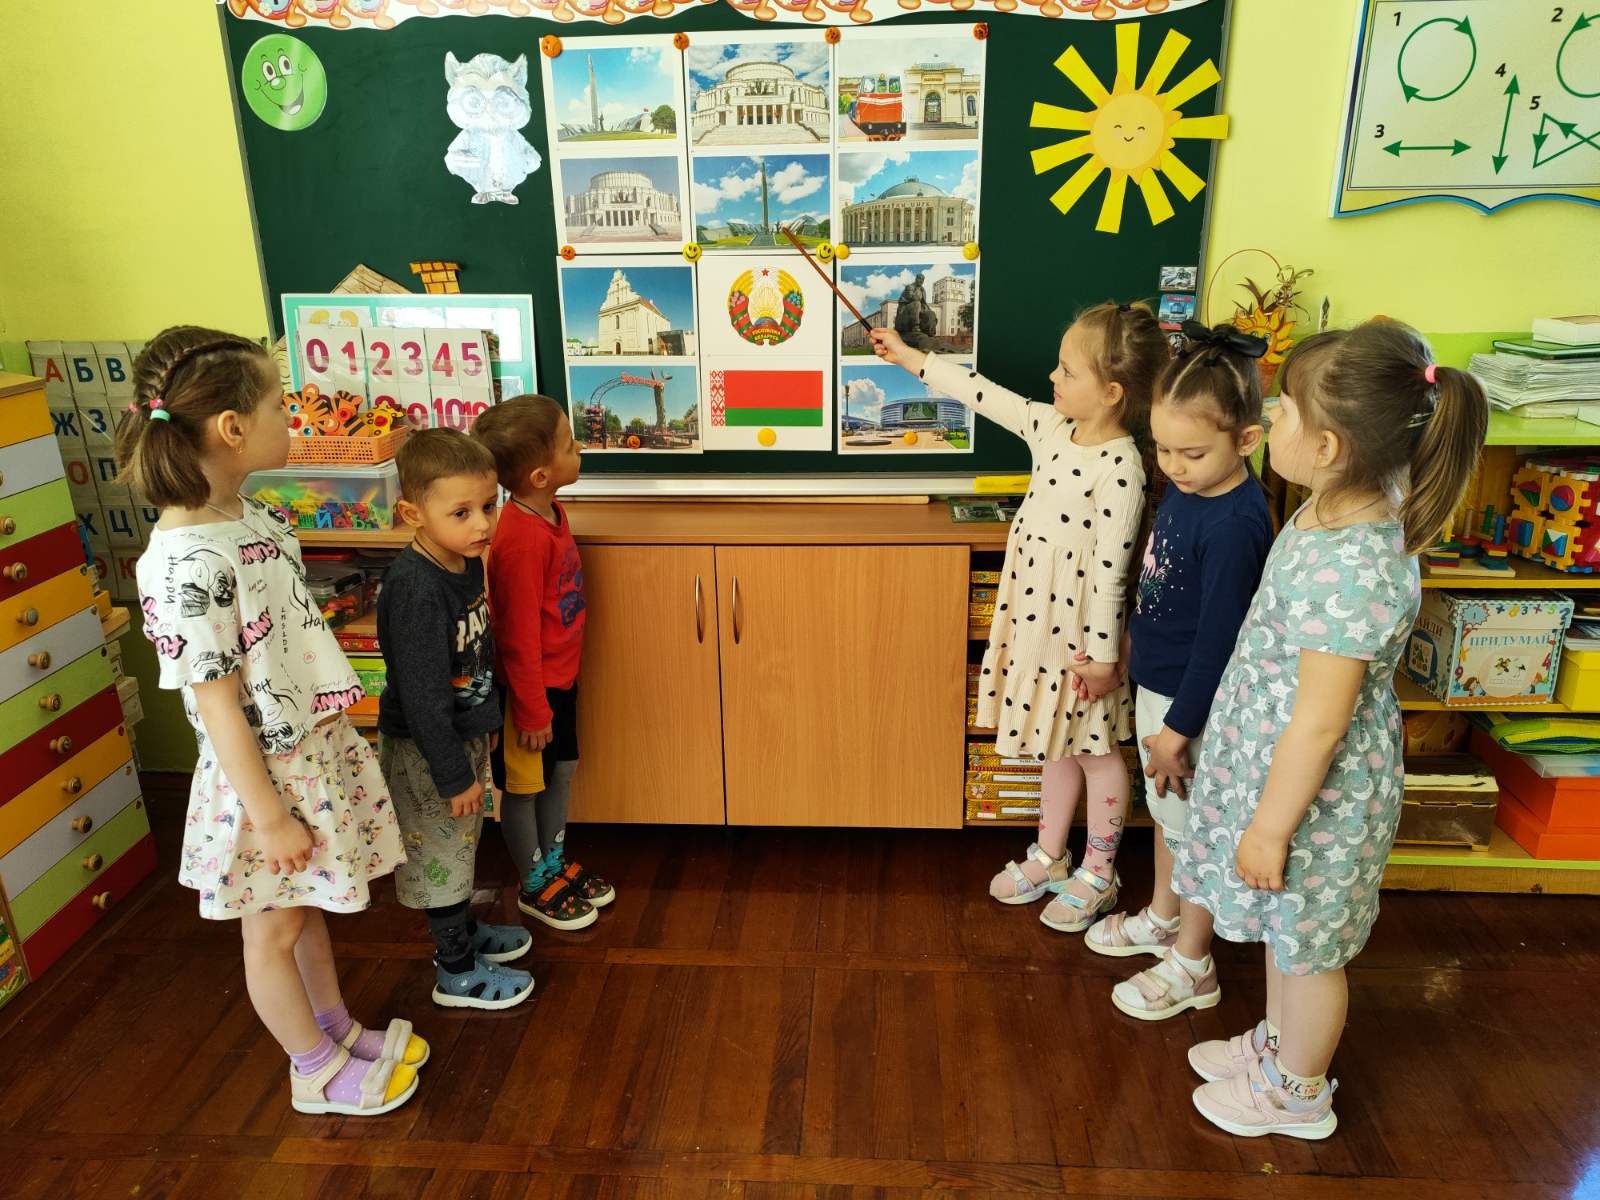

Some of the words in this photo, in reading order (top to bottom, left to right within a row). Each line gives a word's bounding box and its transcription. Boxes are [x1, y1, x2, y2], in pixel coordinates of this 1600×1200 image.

[1393, 11, 1402, 27] 1
[1551, 7, 1564, 23] 2
[1495, 62, 1507, 78] 4
[1529, 95, 1541, 110] 5
[1374, 124, 1385, 139] 3
[305, 338, 330, 374] 0
[340, 340, 358, 376] 1
[369, 340, 393, 376] 2
[400, 340, 424, 376] 3
[431, 342, 454, 378] 4
[461, 342, 483, 377] 5
[45, 357, 65, 383] А
[73, 357, 94, 383] Б
[105, 357, 126, 383] В
[50, 411, 79, 437] Ж
[88, 408, 107, 434] З
[67, 460, 89, 486] О
[98, 457, 118, 482] П
[78, 512, 98, 535] Х
[108, 510, 134, 538] Ц
[1469, 631, 1551, 647] ПРИДУМАЙ
